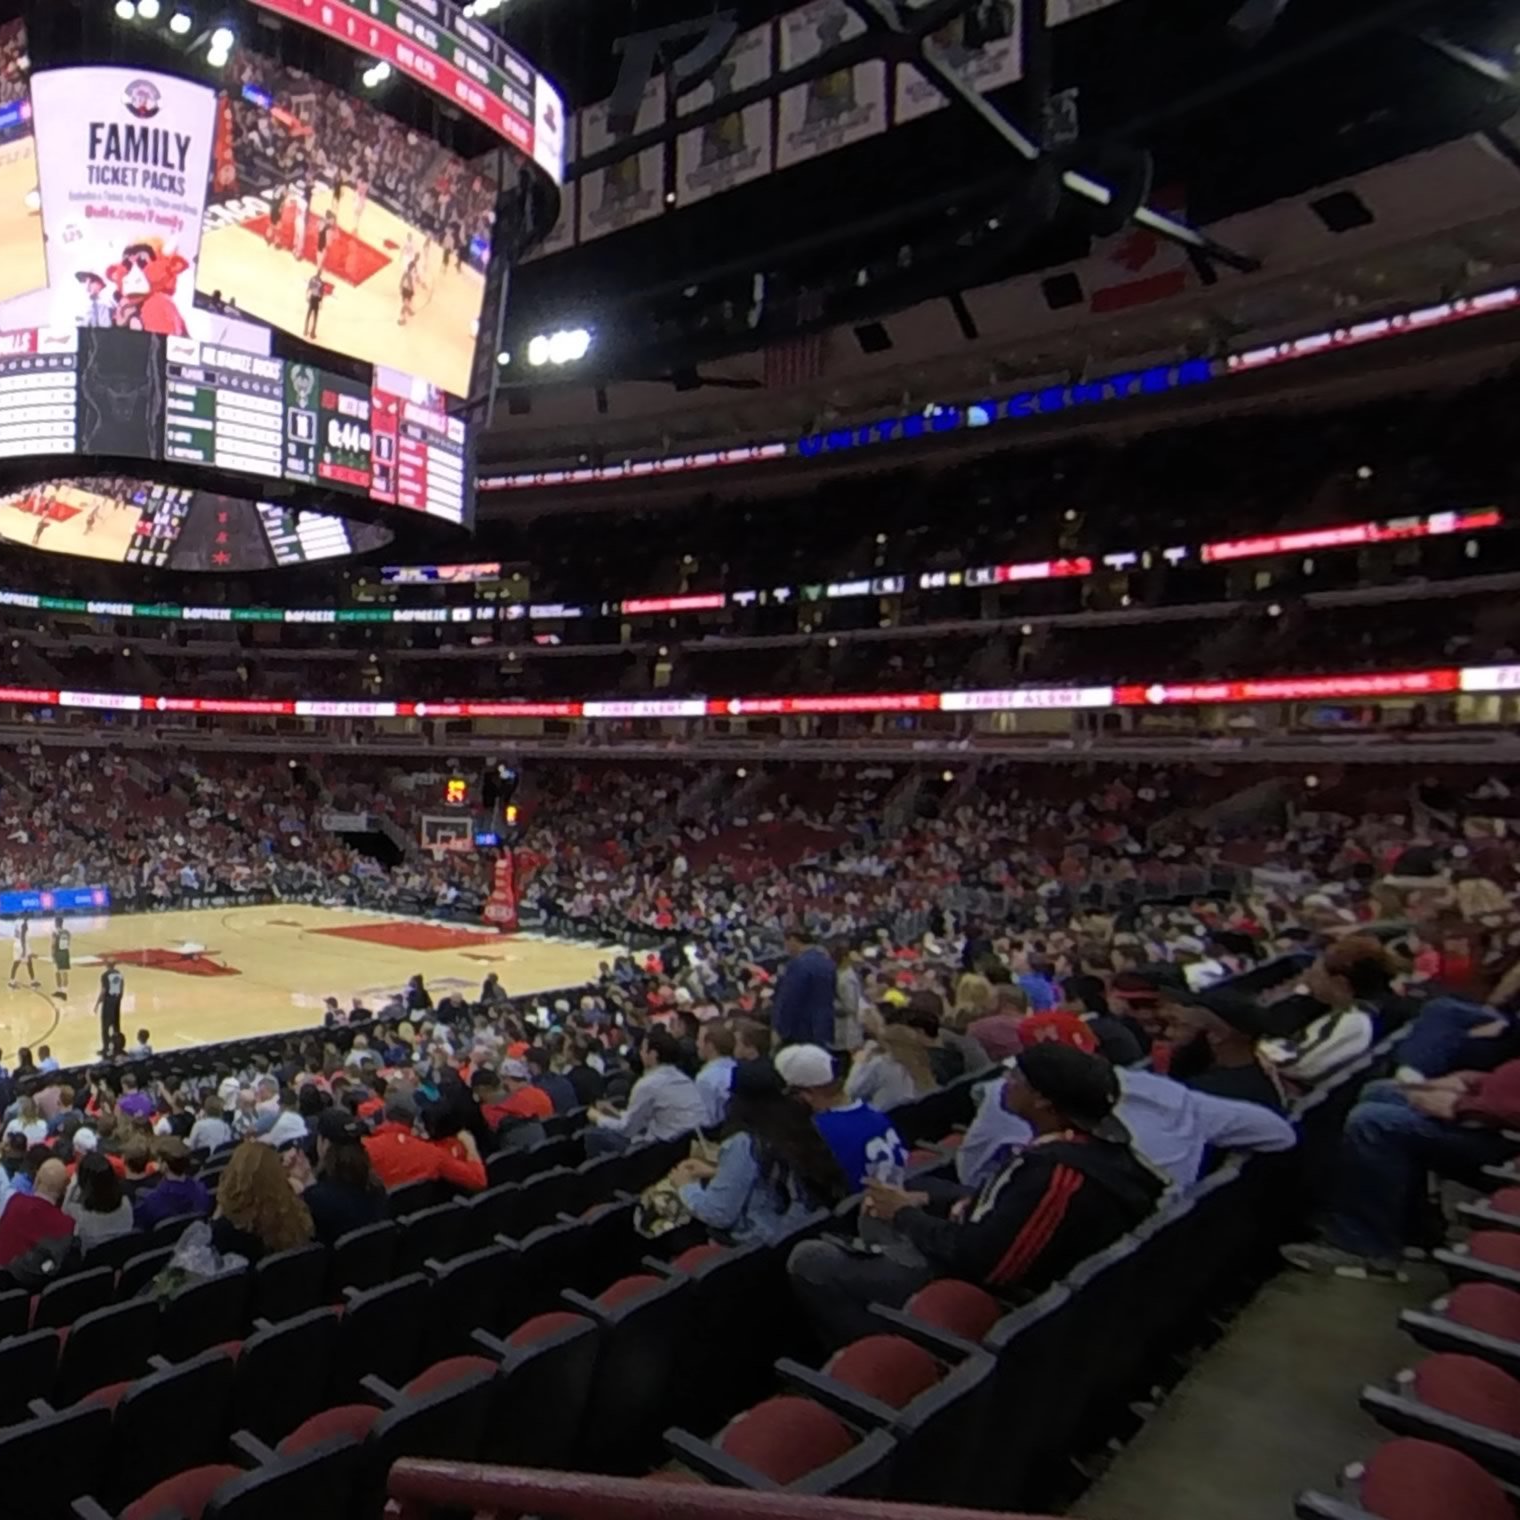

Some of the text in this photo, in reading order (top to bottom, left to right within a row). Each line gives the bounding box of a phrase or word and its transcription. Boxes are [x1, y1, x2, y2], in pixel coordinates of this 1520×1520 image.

[88, 122, 191, 172] FAMILY
[87, 165, 185, 196] TICKET PACKS
[1007, 357, 1214, 417] CENTER
[309, 703, 379, 714] FIRST ALERT
[601, 702, 684, 714] FIRST ALERT
[965, 691, 1083, 707] FIRST ALERT
